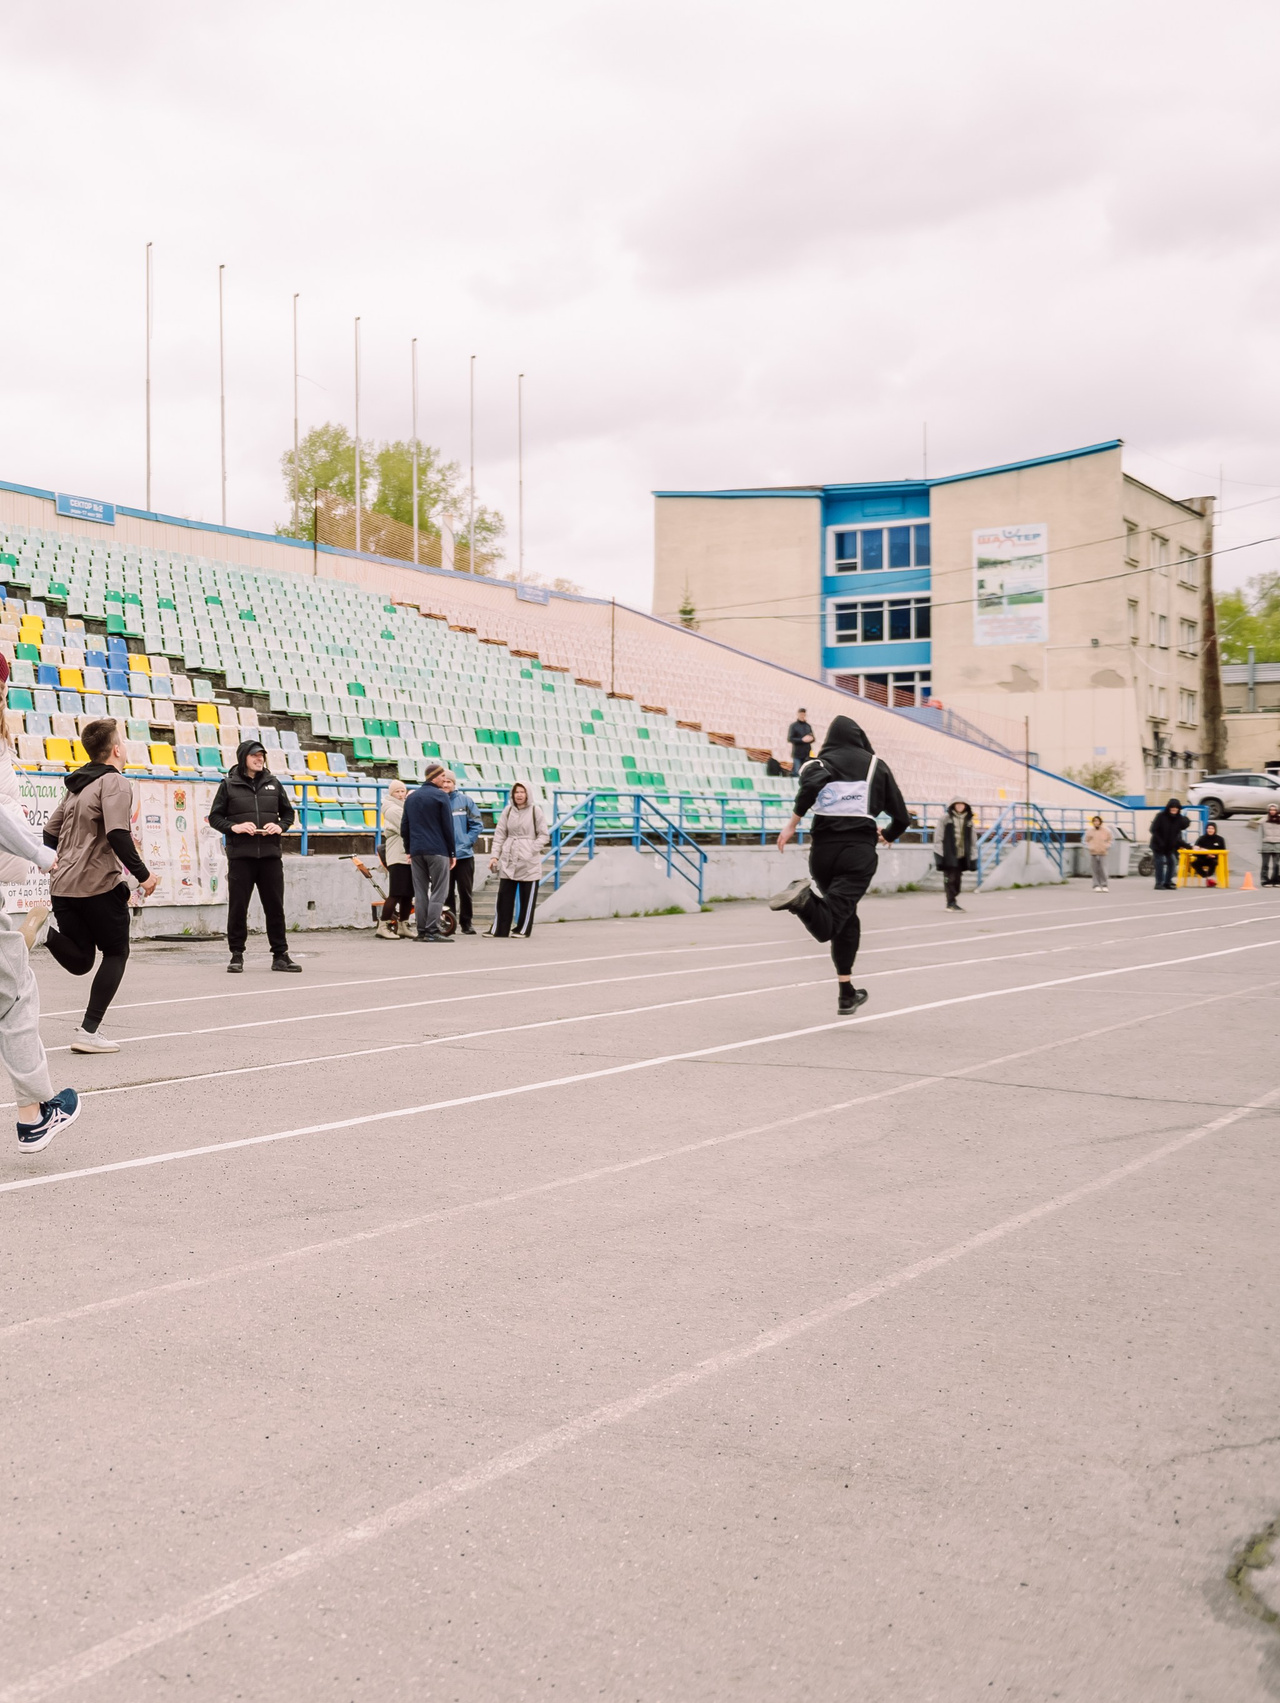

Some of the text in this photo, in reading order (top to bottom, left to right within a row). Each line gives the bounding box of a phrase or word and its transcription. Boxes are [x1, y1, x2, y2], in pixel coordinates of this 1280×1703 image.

[19, 781, 57, 798] тболом
[29, 810, 49, 826] 025
[38, 878, 50, 887] дев
[19, 888, 22, 896] 4
[35, 887, 42, 896] 15
